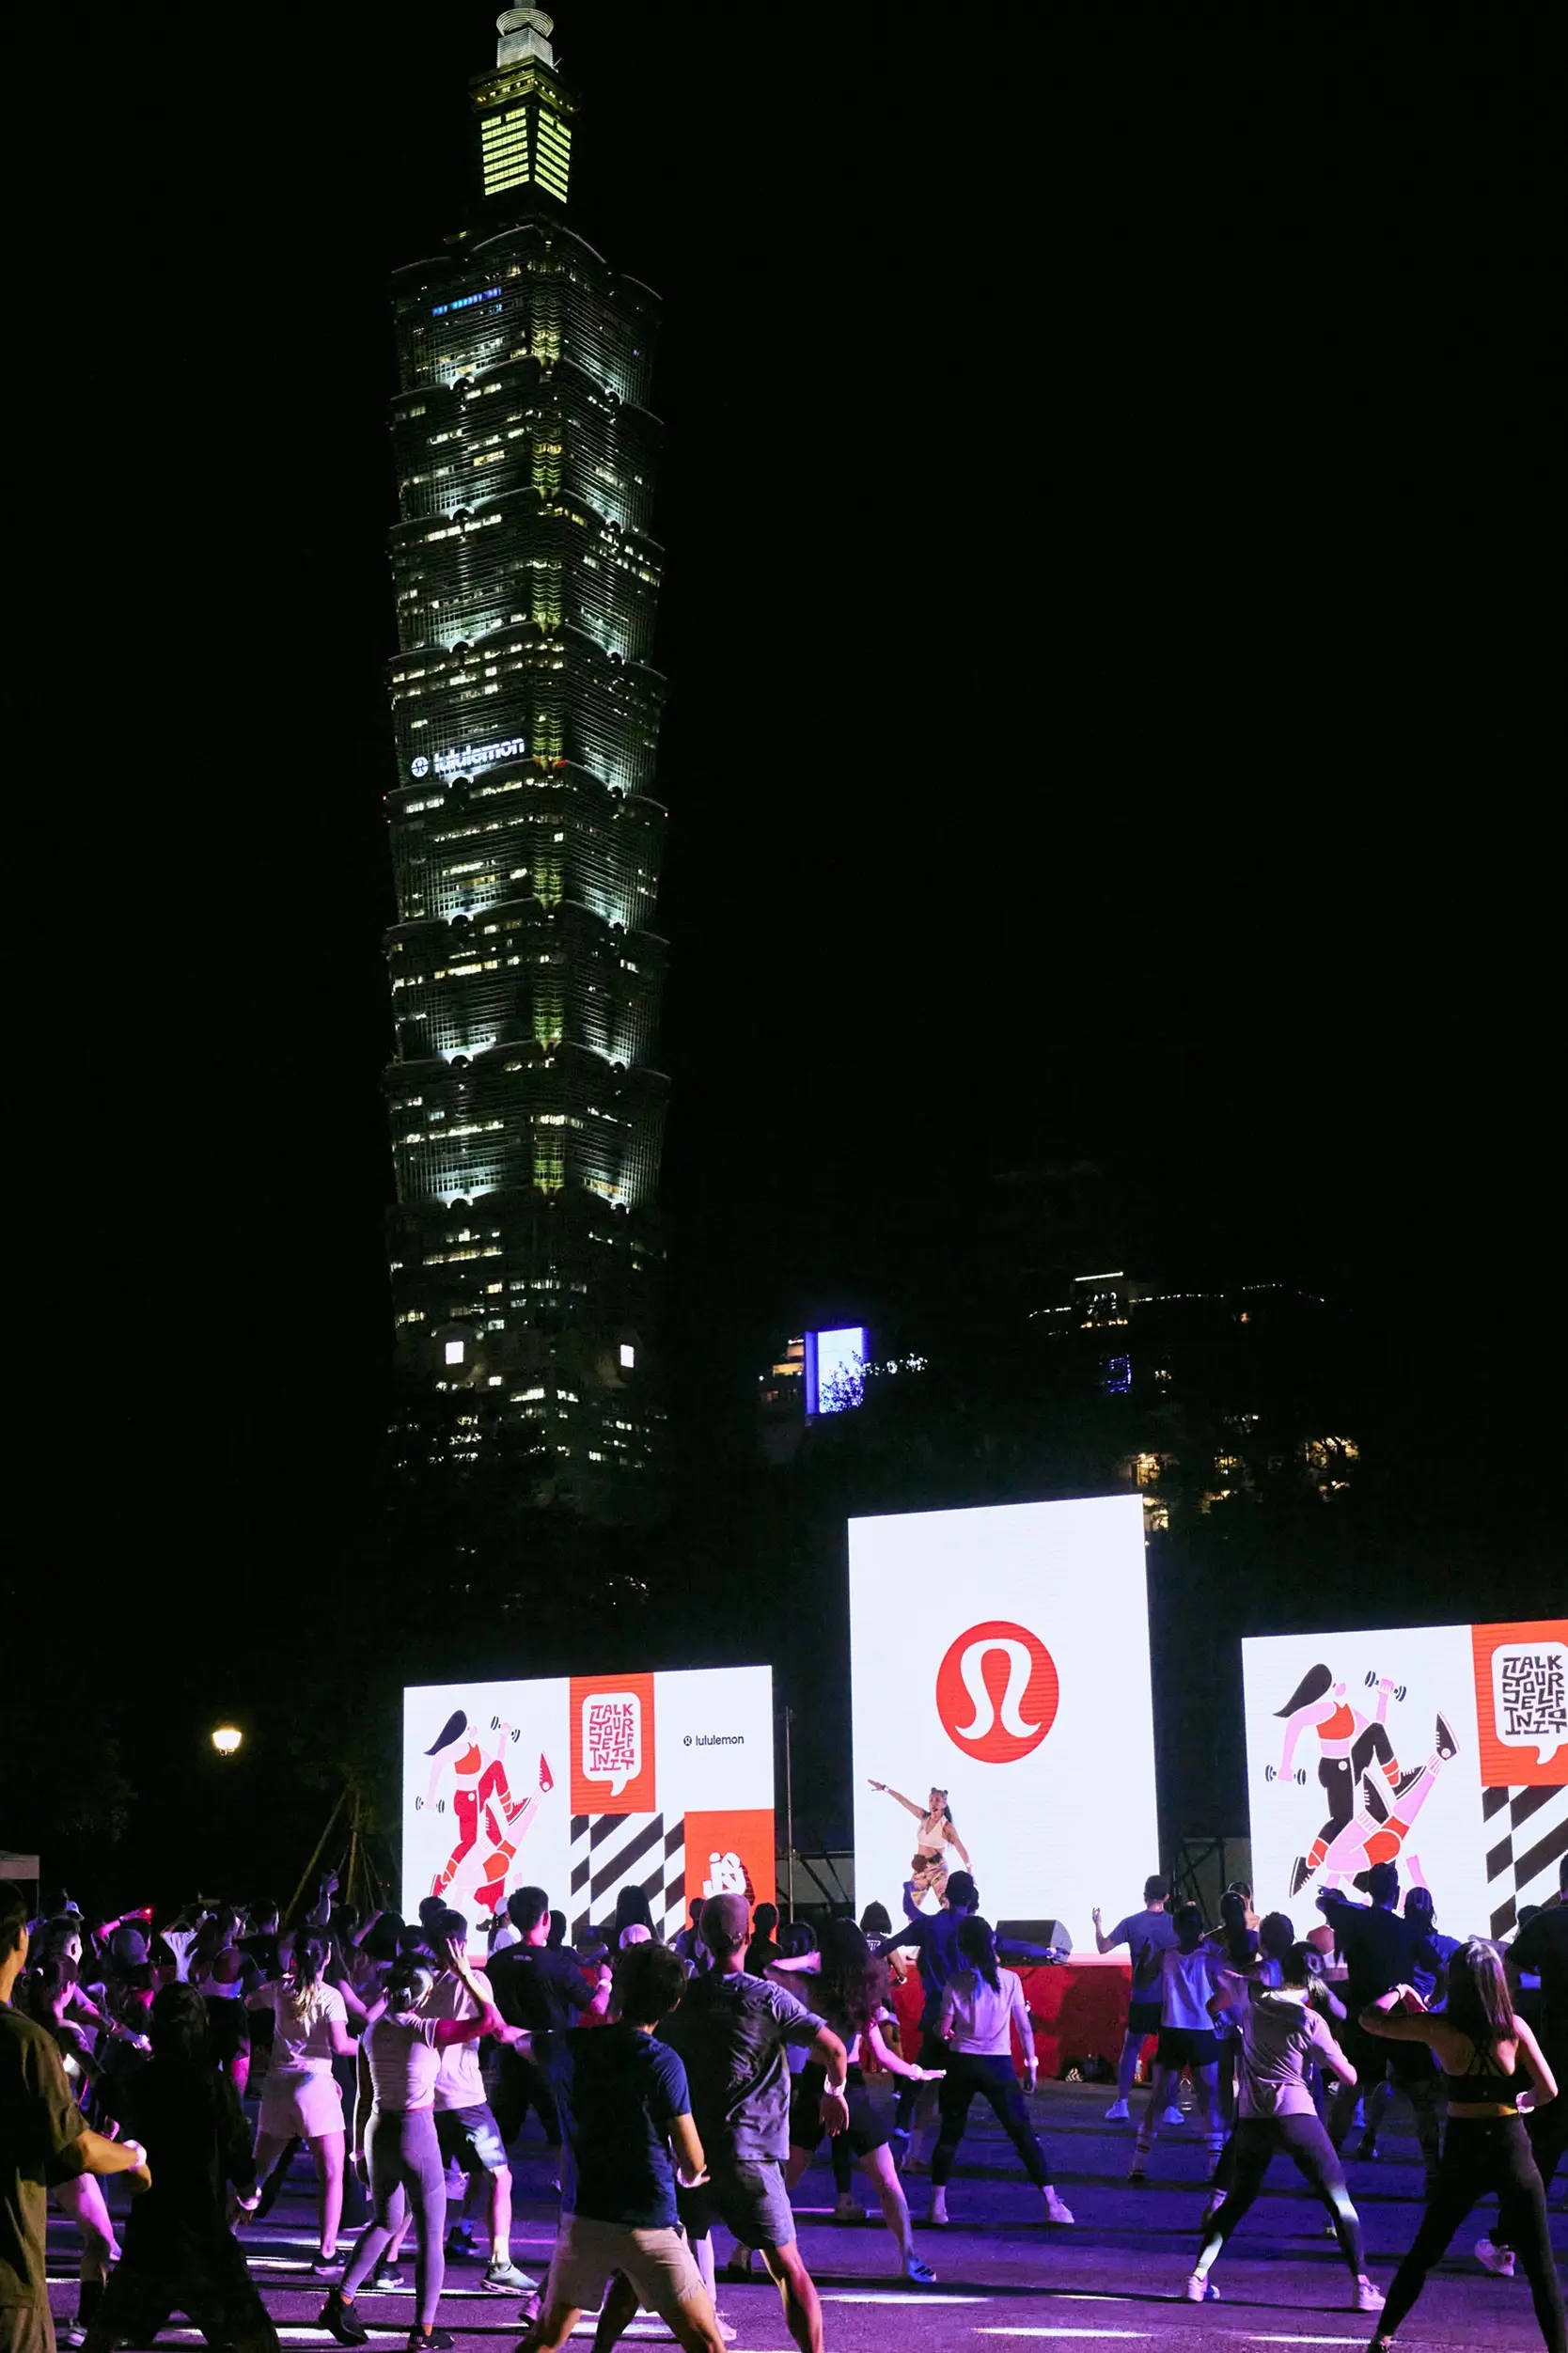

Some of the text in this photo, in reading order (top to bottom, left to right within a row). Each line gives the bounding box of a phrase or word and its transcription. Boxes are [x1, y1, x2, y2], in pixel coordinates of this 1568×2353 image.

[434, 738, 525, 773] lululemon
[1503, 1655, 1562, 1673] TALK
[590, 1703, 634, 1719] TALK
[696, 1734, 745, 1746] lululemon
